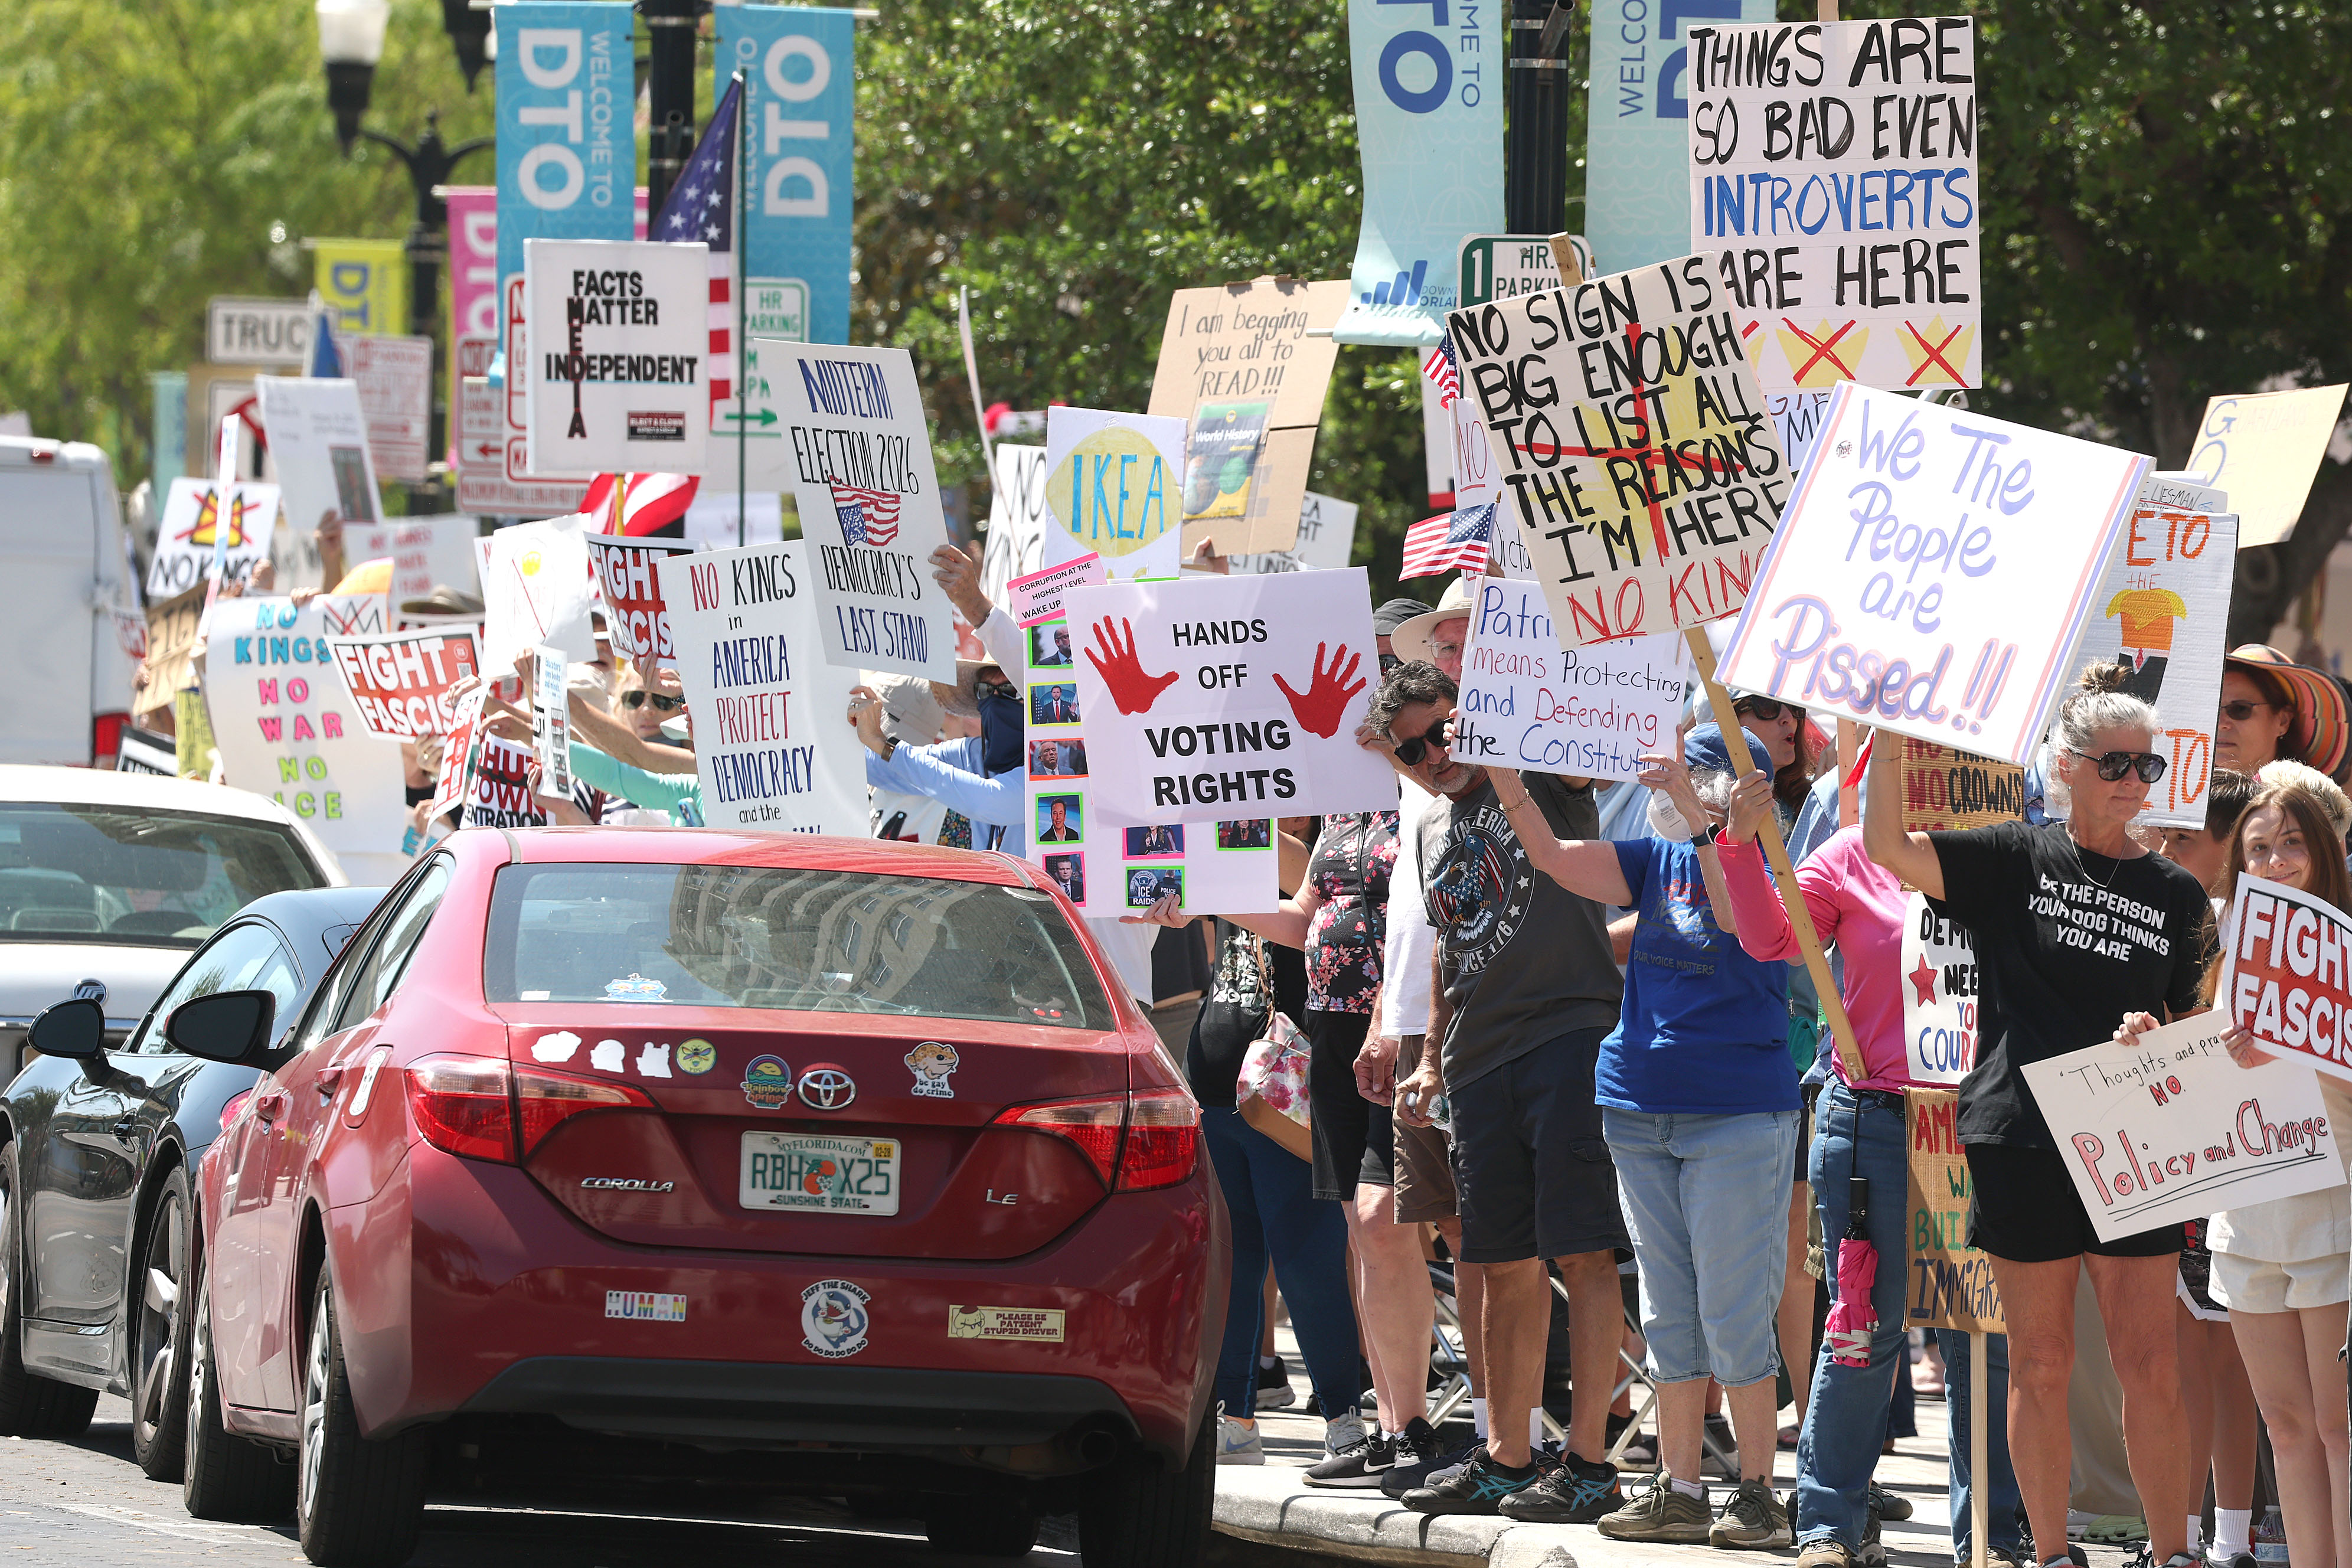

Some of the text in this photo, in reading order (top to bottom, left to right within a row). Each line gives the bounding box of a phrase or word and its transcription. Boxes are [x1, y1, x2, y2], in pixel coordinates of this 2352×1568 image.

[1690, 18, 1973, 92] THINGS ARE
[1461, 63, 1481, 107] TO
[518, 28, 584, 210] DTO
[591, 31, 613, 207] WELCOME TO
[764, 35, 831, 217] DTO
[1695, 94, 1974, 166] SO BAD EVEN
[1704, 168, 1973, 237] INTROVERTS
[573, 269, 643, 296] FACTS
[1472, 249, 1483, 298] 1
[1719, 239, 1969, 310] ARE HERE
[567, 297, 658, 325] MATTER
[759, 290, 783, 309] HR
[1449, 257, 1712, 362] NO SIGN IS
[745, 313, 799, 332] ARKING
[1179, 303, 1308, 342] I am begging
[545, 352, 698, 383] INDEPENDENT
[1194, 331, 1294, 375] you all to
[1470, 311, 1745, 422] BIG ENOUGH
[797, 358, 894, 420] MIDTERM
[1198, 365, 1285, 398] READ!!!
[1195, 428, 1260, 442] World History
[1488, 373, 1764, 470] TO LIST ALL
[790, 426, 919, 495] ELECTION 2026
[1458, 420, 1488, 486] NO
[1859, 398, 1925, 481] We
[1951, 423, 2035, 516] The
[1010, 449, 1047, 525] NO
[1070, 453, 1165, 540] IKEA
[1505, 465, 1596, 529] THE
[1606, 424, 1779, 511] REASONS
[1545, 479, 1788, 583] I'M HERE
[1845, 481, 1997, 584] People
[149, 554, 193, 588] NO
[589, 543, 668, 602] FIGHT
[690, 553, 796, 612] NO KINGS
[821, 544, 922, 600] DEMOCRACY'S
[1019, 561, 1092, 592] CORRUPTION AT THE
[1032, 576, 1087, 600] HIGHEST LEVEL
[256, 602, 298, 629] NO
[1022, 599, 1061, 619] WAKE UP
[1567, 576, 1645, 640] NO
[1859, 570, 1943, 634] are
[728, 614, 743, 631] in
[837, 605, 927, 664] LAST STAND
[1172, 619, 1268, 647] HANDS
[234, 636, 332, 667] KINGS
[335, 636, 447, 691] FIGHT
[713, 635, 791, 689] AMERICA
[1766, 593, 2019, 736] Pissed!!
[259, 678, 309, 705] NO
[1198, 664, 1248, 690] OFF
[1473, 647, 1681, 702] means Protecting
[259, 712, 344, 743] WAR
[716, 691, 792, 745] PROTECT
[1454, 717, 1505, 756] the
[1465, 685, 1658, 748] and Defending
[1144, 719, 1291, 758] VOTING
[279, 756, 327, 784] NO
[711, 744, 814, 803] DEMOCRACY
[1152, 767, 1297, 807] RIGHTS
[1907, 766, 2021, 817] NO CROWNS
[739, 803, 782, 824] and the
[1138, 886, 1151, 897] ICE
[1160, 887, 1177, 895] POLICE
[2062, 883, 2095, 904] THE
[2095, 889, 2166, 930] PERSON
[2027, 893, 2170, 957] YOUR DOG THINKS
[2056, 923, 2132, 962] YOU ARE
[1650, 953, 1716, 976] VOICE MATTERS
[2175, 1041, 2195, 1061] and
[746, 1083, 787, 1094] Rainbow
[919, 1078, 946, 1089] be gay
[926, 1088, 952, 1096] crime
[778, 1139, 867, 1157] MYFLORIDA.COM
[2070, 1098, 2327, 1206] Policy and Change
[581, 1177, 674, 1193] COROLLA
[752, 1152, 891, 1195] RBH X25
[775, 1194, 864, 1209] SUNSHINE STATE
[986, 1188, 1019, 1206] LE
[607, 1292, 685, 1320] HUMAN
[802, 1280, 870, 1302] JEFF THE SHARK
[984, 1327, 1021, 1335] STUPID
[996, 1313, 1033, 1321] PLEASE
[803, 1339, 814, 1348] DO
[813, 1345, 824, 1354] DO
[846, 1346, 857, 1354] DO
[856, 1340, 867, 1349] DO
